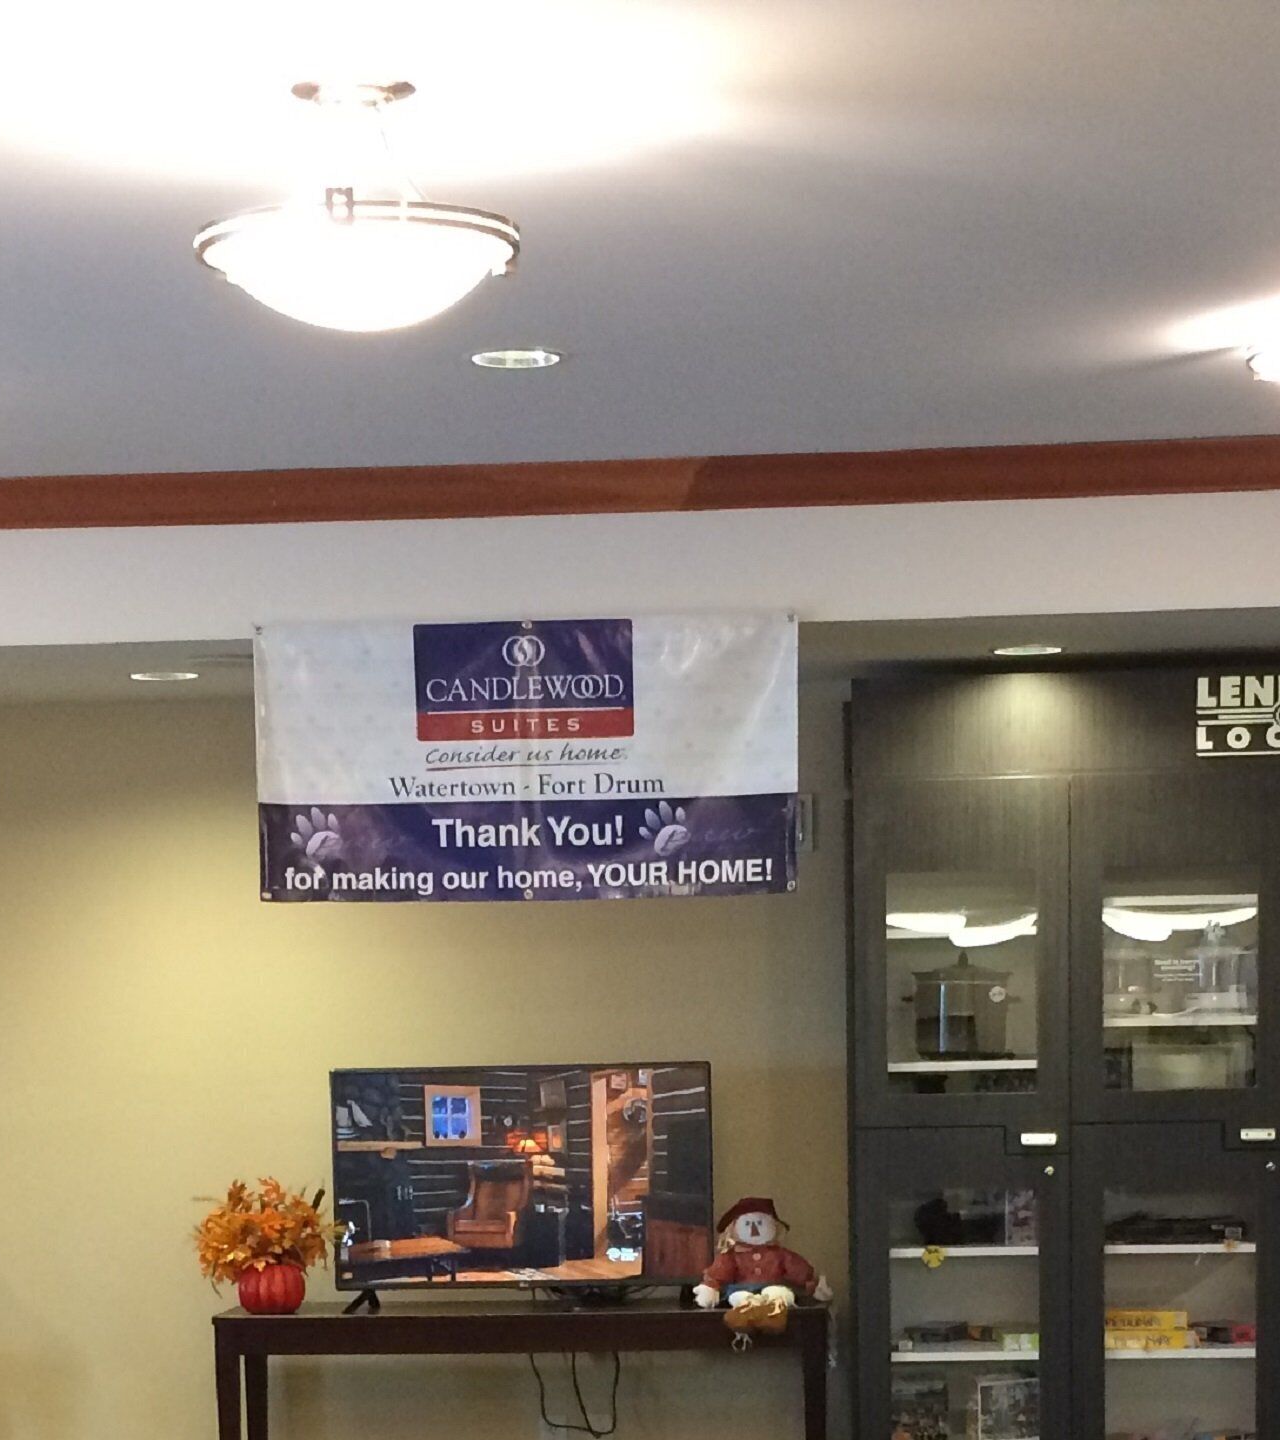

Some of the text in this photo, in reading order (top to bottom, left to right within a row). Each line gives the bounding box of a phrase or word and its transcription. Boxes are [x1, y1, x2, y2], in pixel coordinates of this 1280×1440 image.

[425, 674, 624, 703] CANDLEWOOD
[471, 718, 581, 734] SUITES
[424, 744, 520, 765] Consider
[526, 748, 551, 761] us
[388, 775, 516, 799] Watertown
[538, 773, 587, 796] Fort
[593, 772, 666, 795] Drum
[431, 815, 624, 848] Thank You!
[284, 858, 773, 895] for making our home, YOUR HOME!
